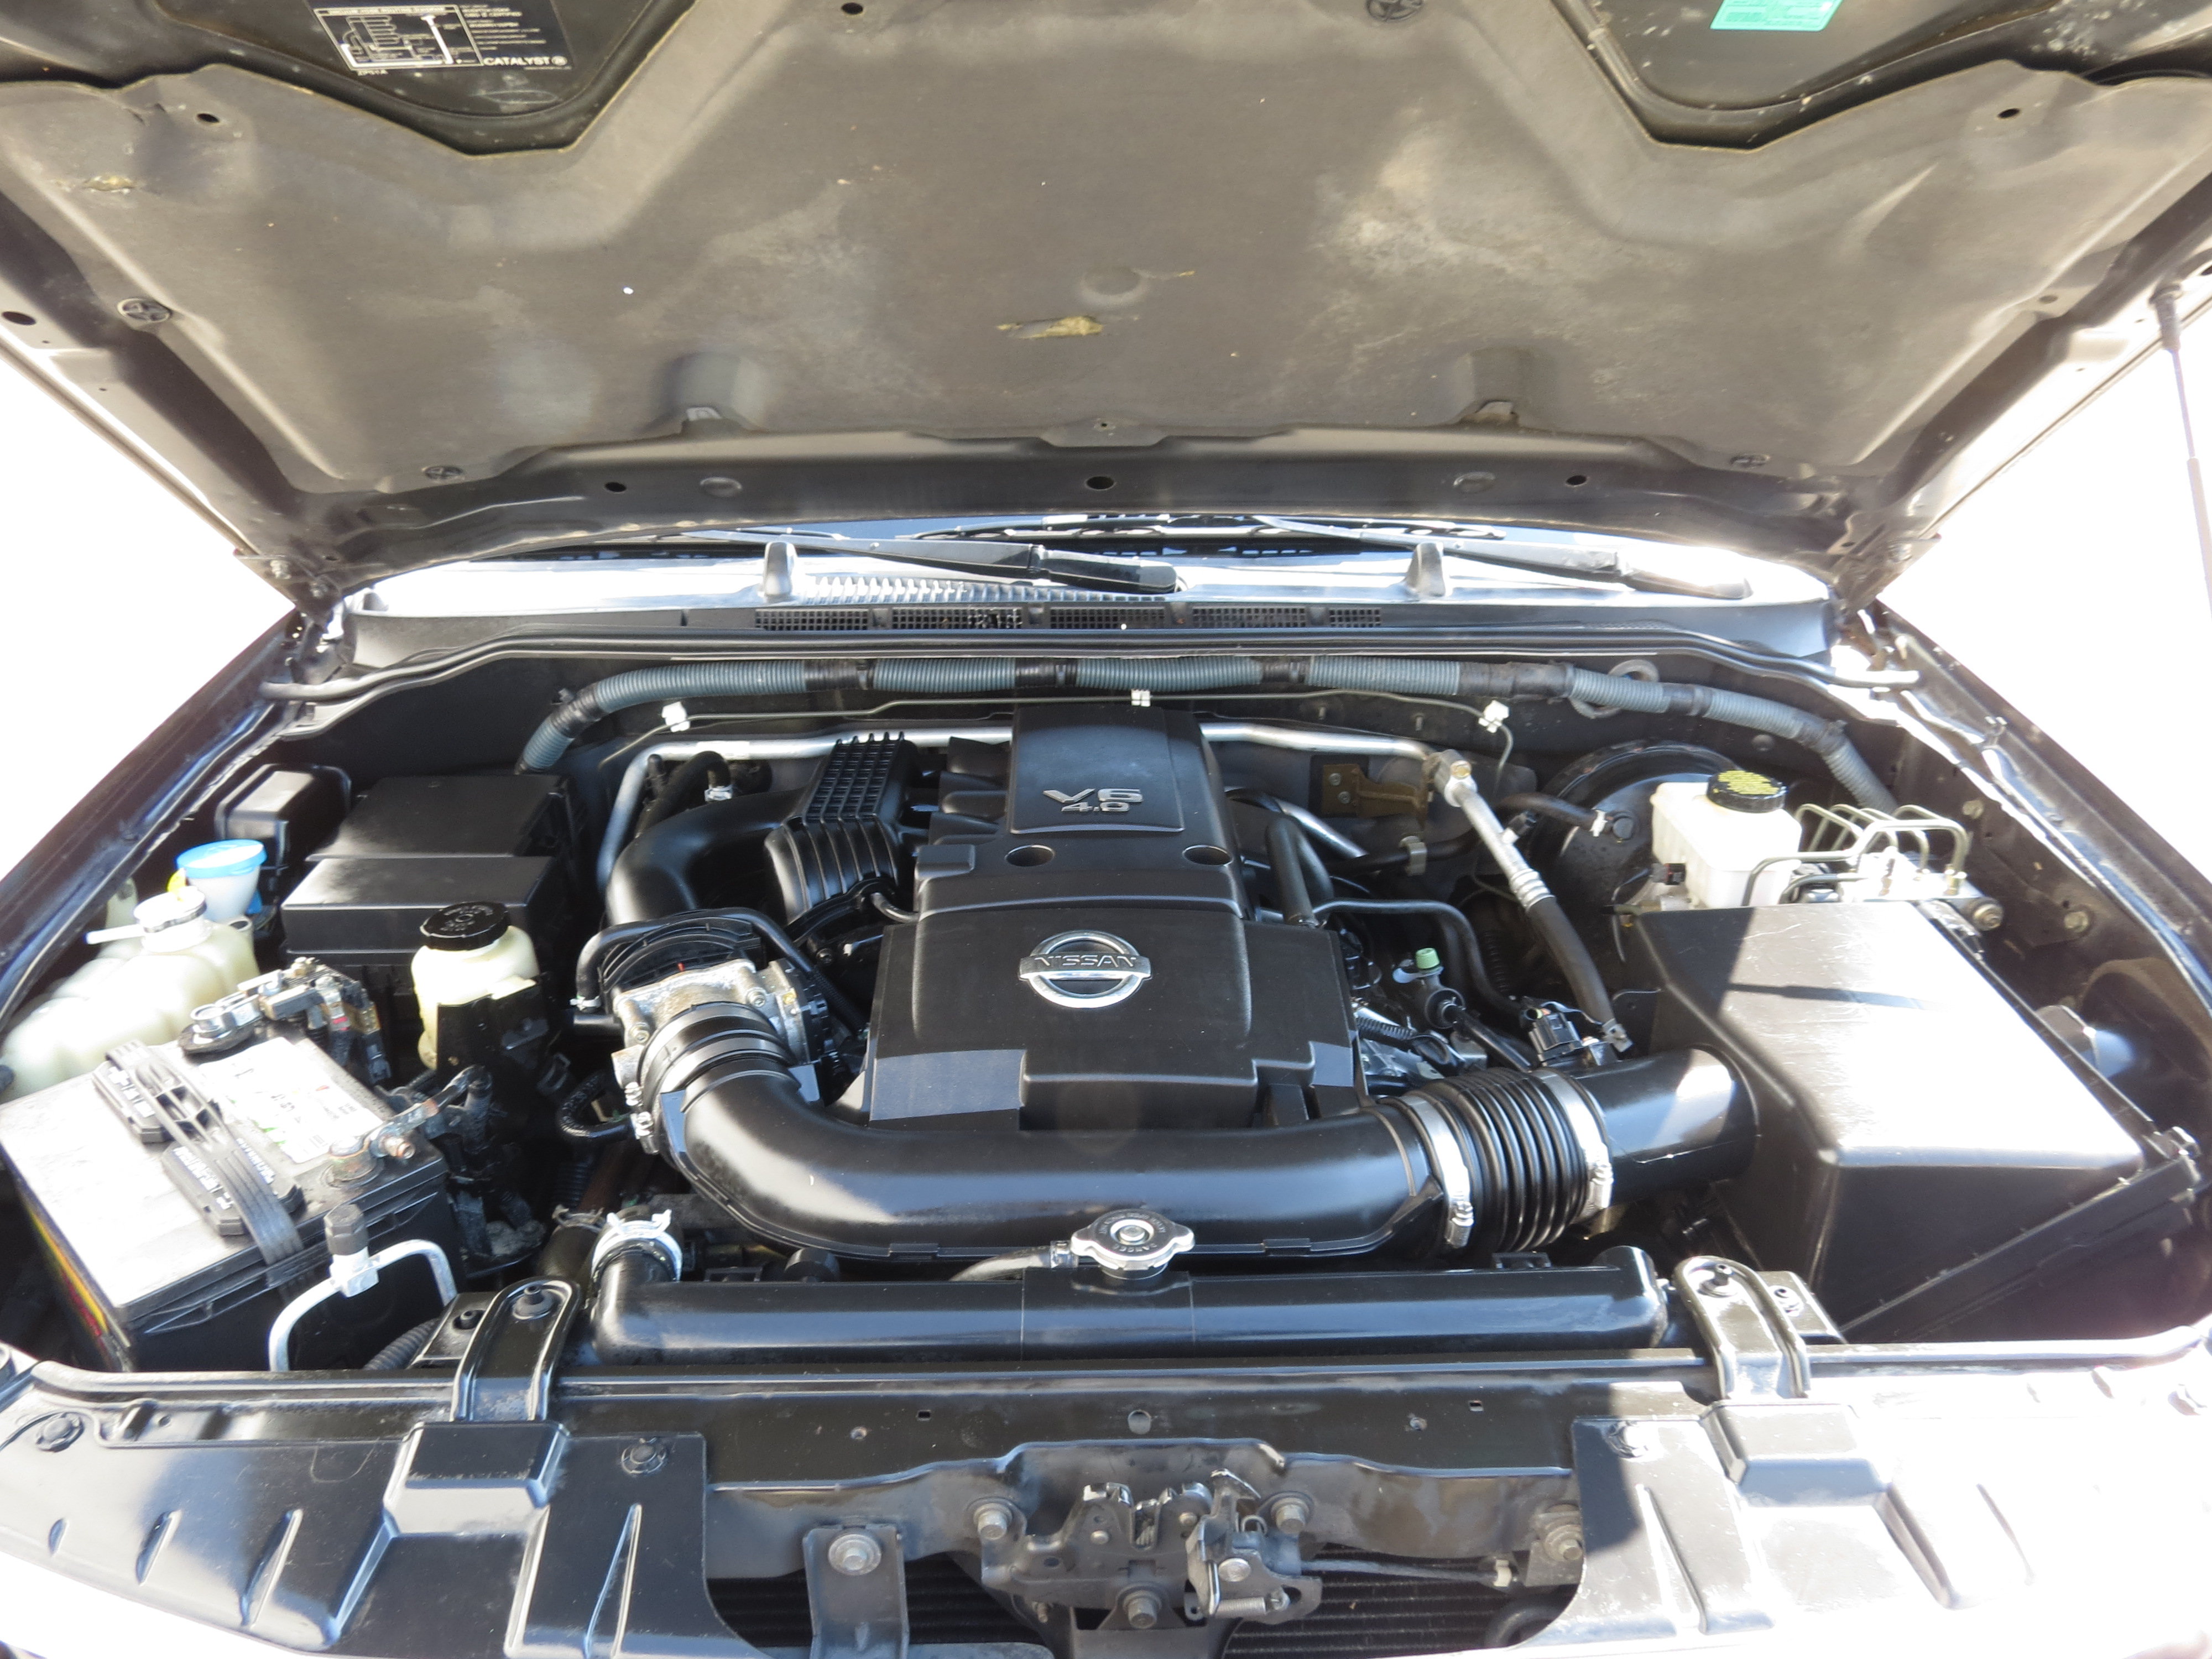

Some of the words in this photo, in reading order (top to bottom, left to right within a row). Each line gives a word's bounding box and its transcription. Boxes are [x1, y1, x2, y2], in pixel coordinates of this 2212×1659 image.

[483, 56, 551, 66] CATALYST
[1043, 788, 1144, 802] V6
[1061, 802, 1130, 812] 4.0
[1034, 955, 1137, 968] NISSAN
